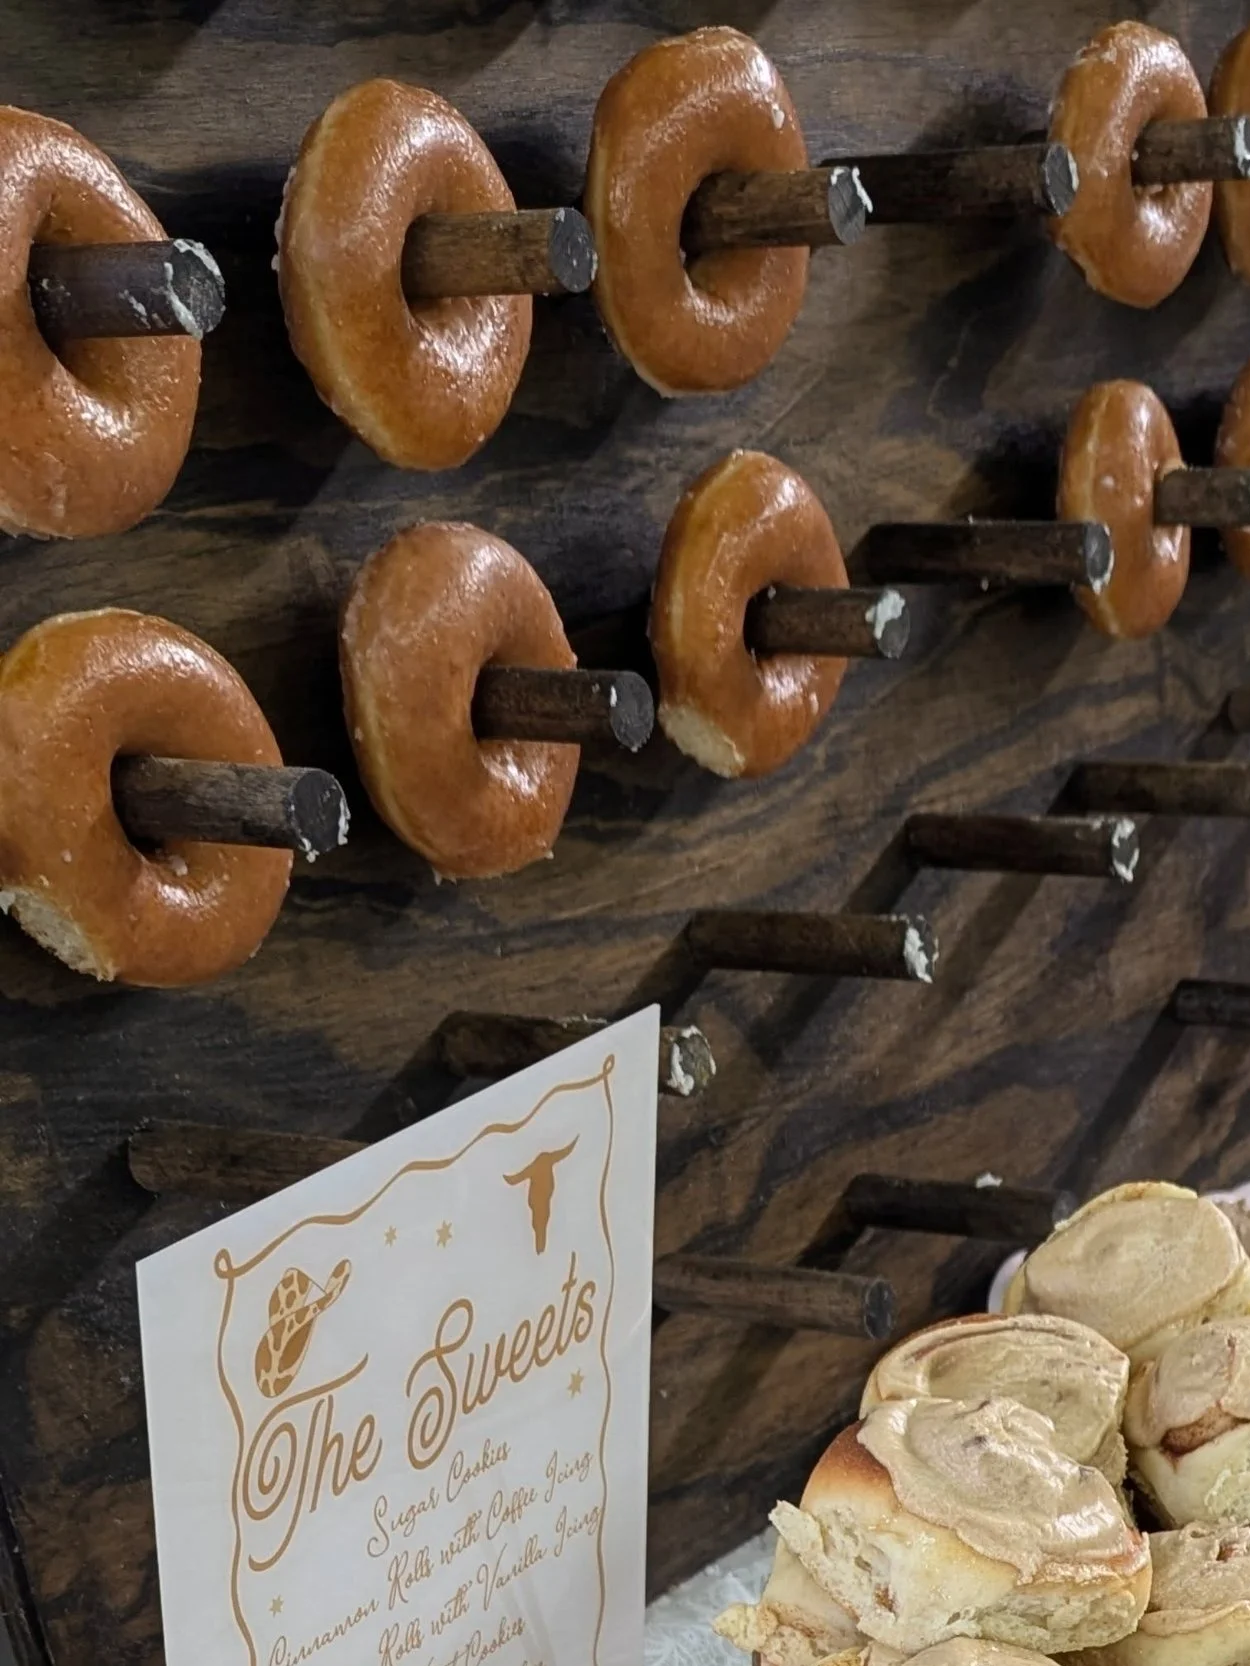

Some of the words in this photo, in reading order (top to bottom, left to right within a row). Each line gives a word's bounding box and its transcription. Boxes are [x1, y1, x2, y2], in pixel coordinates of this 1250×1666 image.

[243, 1352, 383, 1572] The
[406, 1251, 597, 1471] Sweets
[367, 1487, 440, 1558] Sugar
[446, 1438, 511, 1502] Cookies
[388, 1546, 434, 1611] Rolls
[440, 1510, 482, 1565] with
[486, 1487, 537, 1541] Coffee
[544, 1450, 593, 1503] Icing
[431, 1580, 473, 1636] with
[477, 1534, 548, 1612] Vanilla
[554, 1505, 601, 1558] Icing
